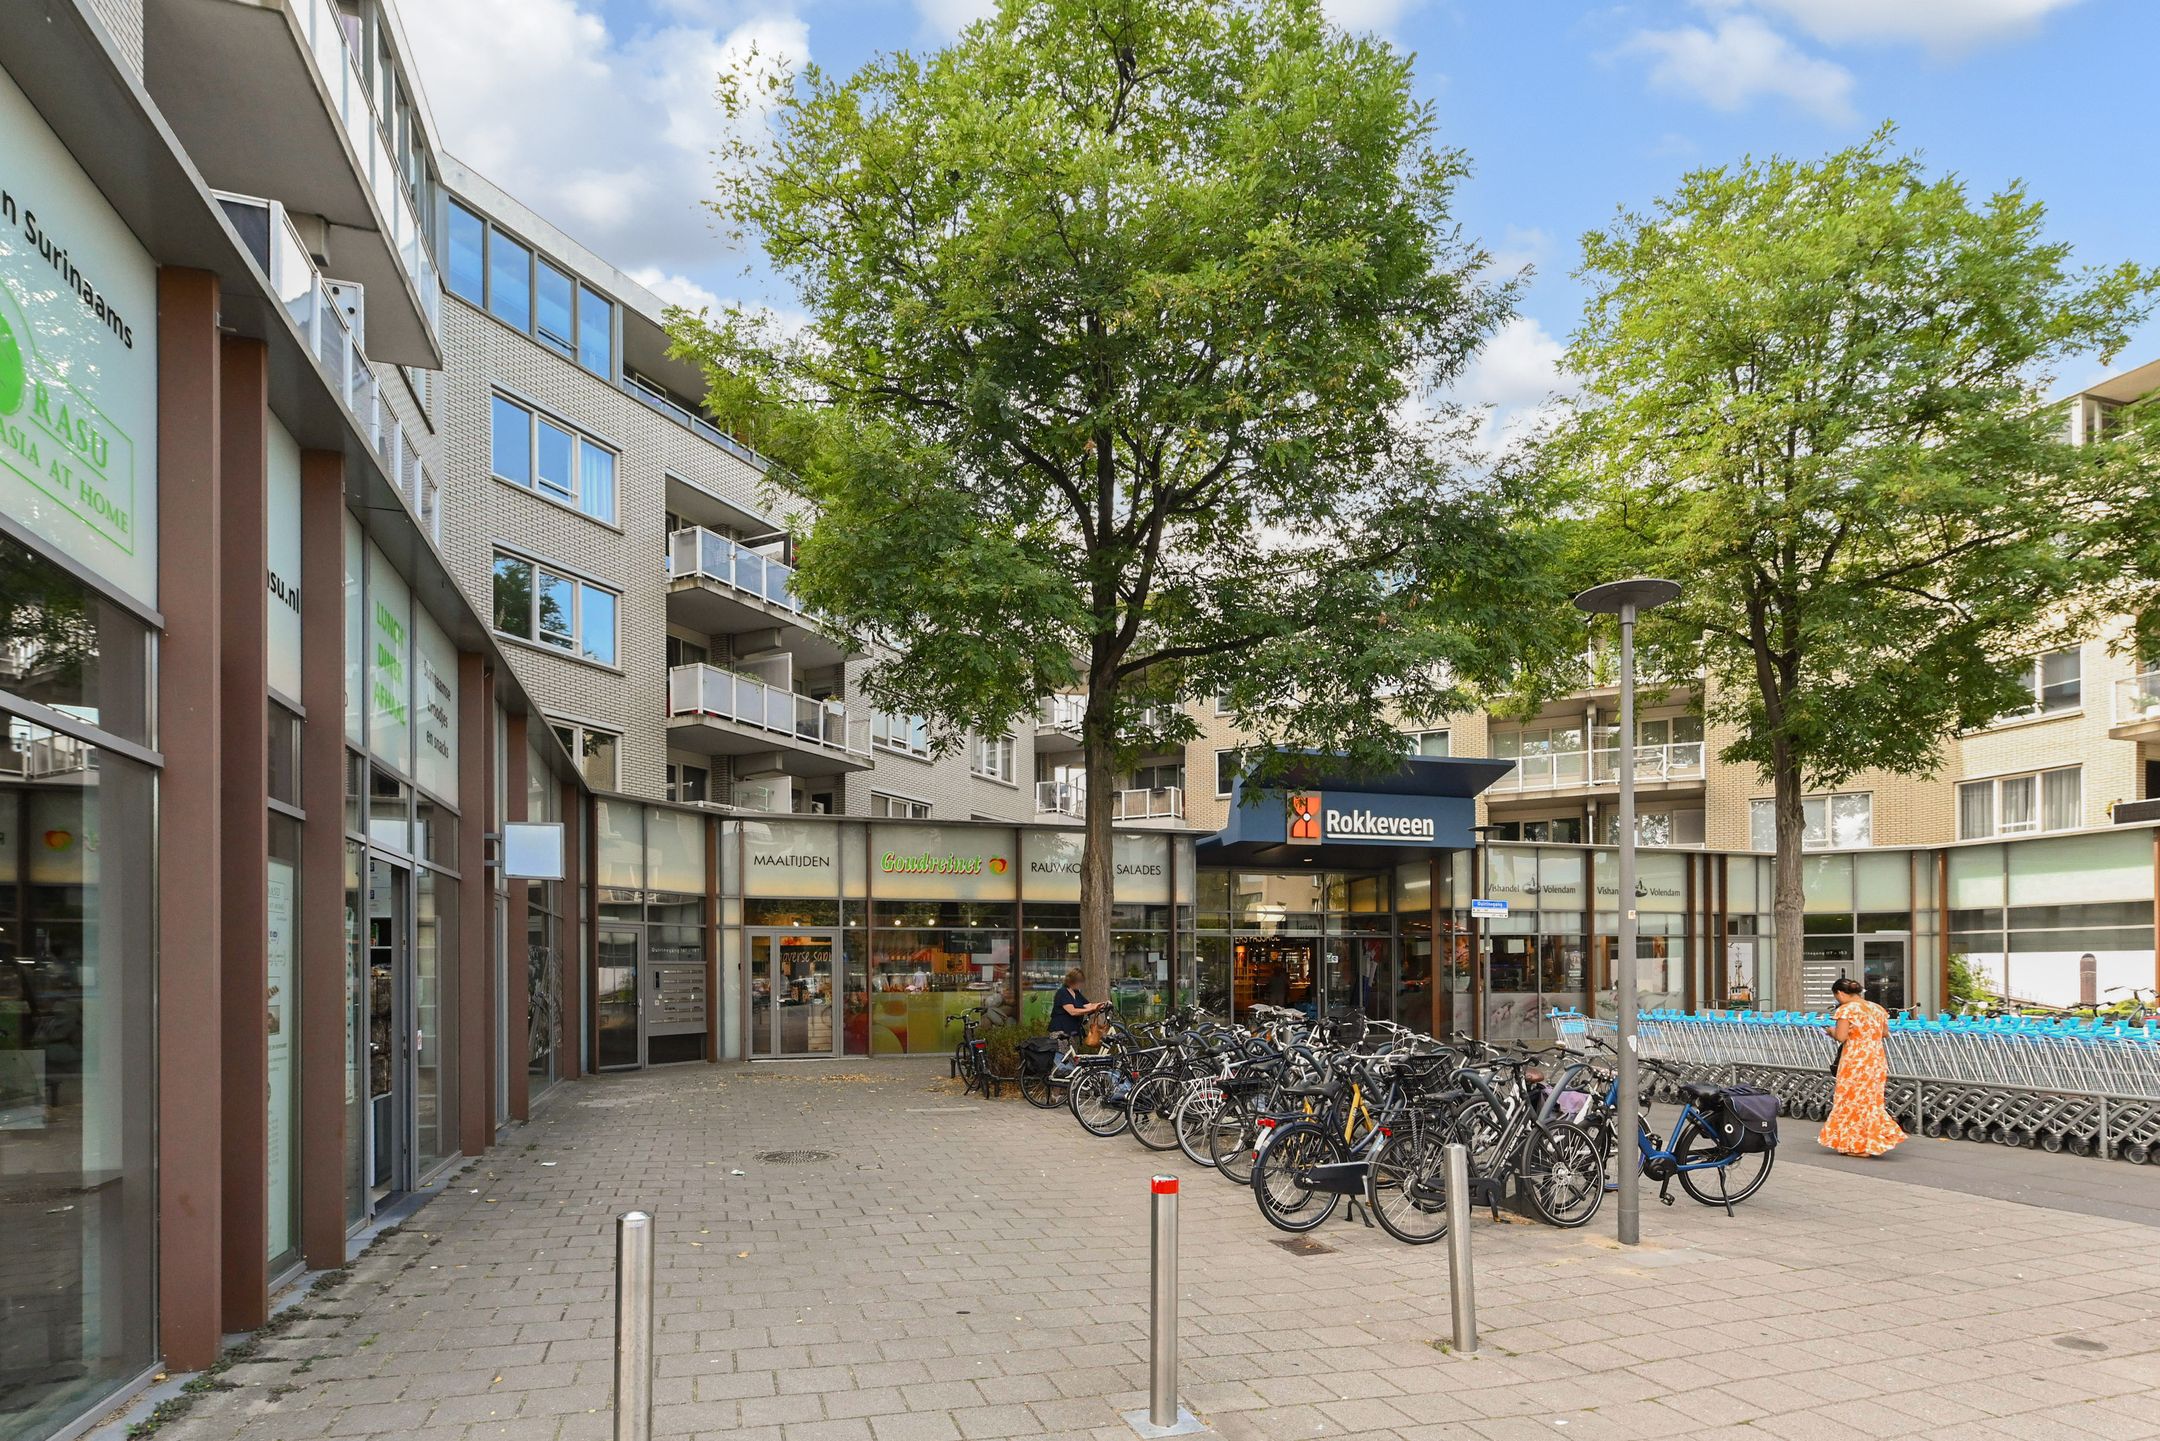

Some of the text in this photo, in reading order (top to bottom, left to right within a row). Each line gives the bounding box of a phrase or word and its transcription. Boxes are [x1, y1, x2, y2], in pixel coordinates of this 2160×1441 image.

[2, 189, 134, 350] n Surinaams
[0, 416, 129, 535] ASIA AT HOME
[376, 600, 406, 649] LUNCH
[377, 642, 403, 686] DINER
[423, 659, 451, 702] Surinaamse
[374, 680, 406, 727] AFHAAL
[427, 696, 449, 729] broodjes
[425, 730, 449, 759] en snacks
[1326, 809, 1435, 836] Rokkeveen
[753, 855, 830, 868] MAALTIJDEN
[880, 850, 982, 875] Goudreinet
[1030, 861, 1162, 876] RAUWKO SALADES
[1542, 885, 1576, 894] Volendam
[1596, 886, 1681, 897] Vishan Volendam
